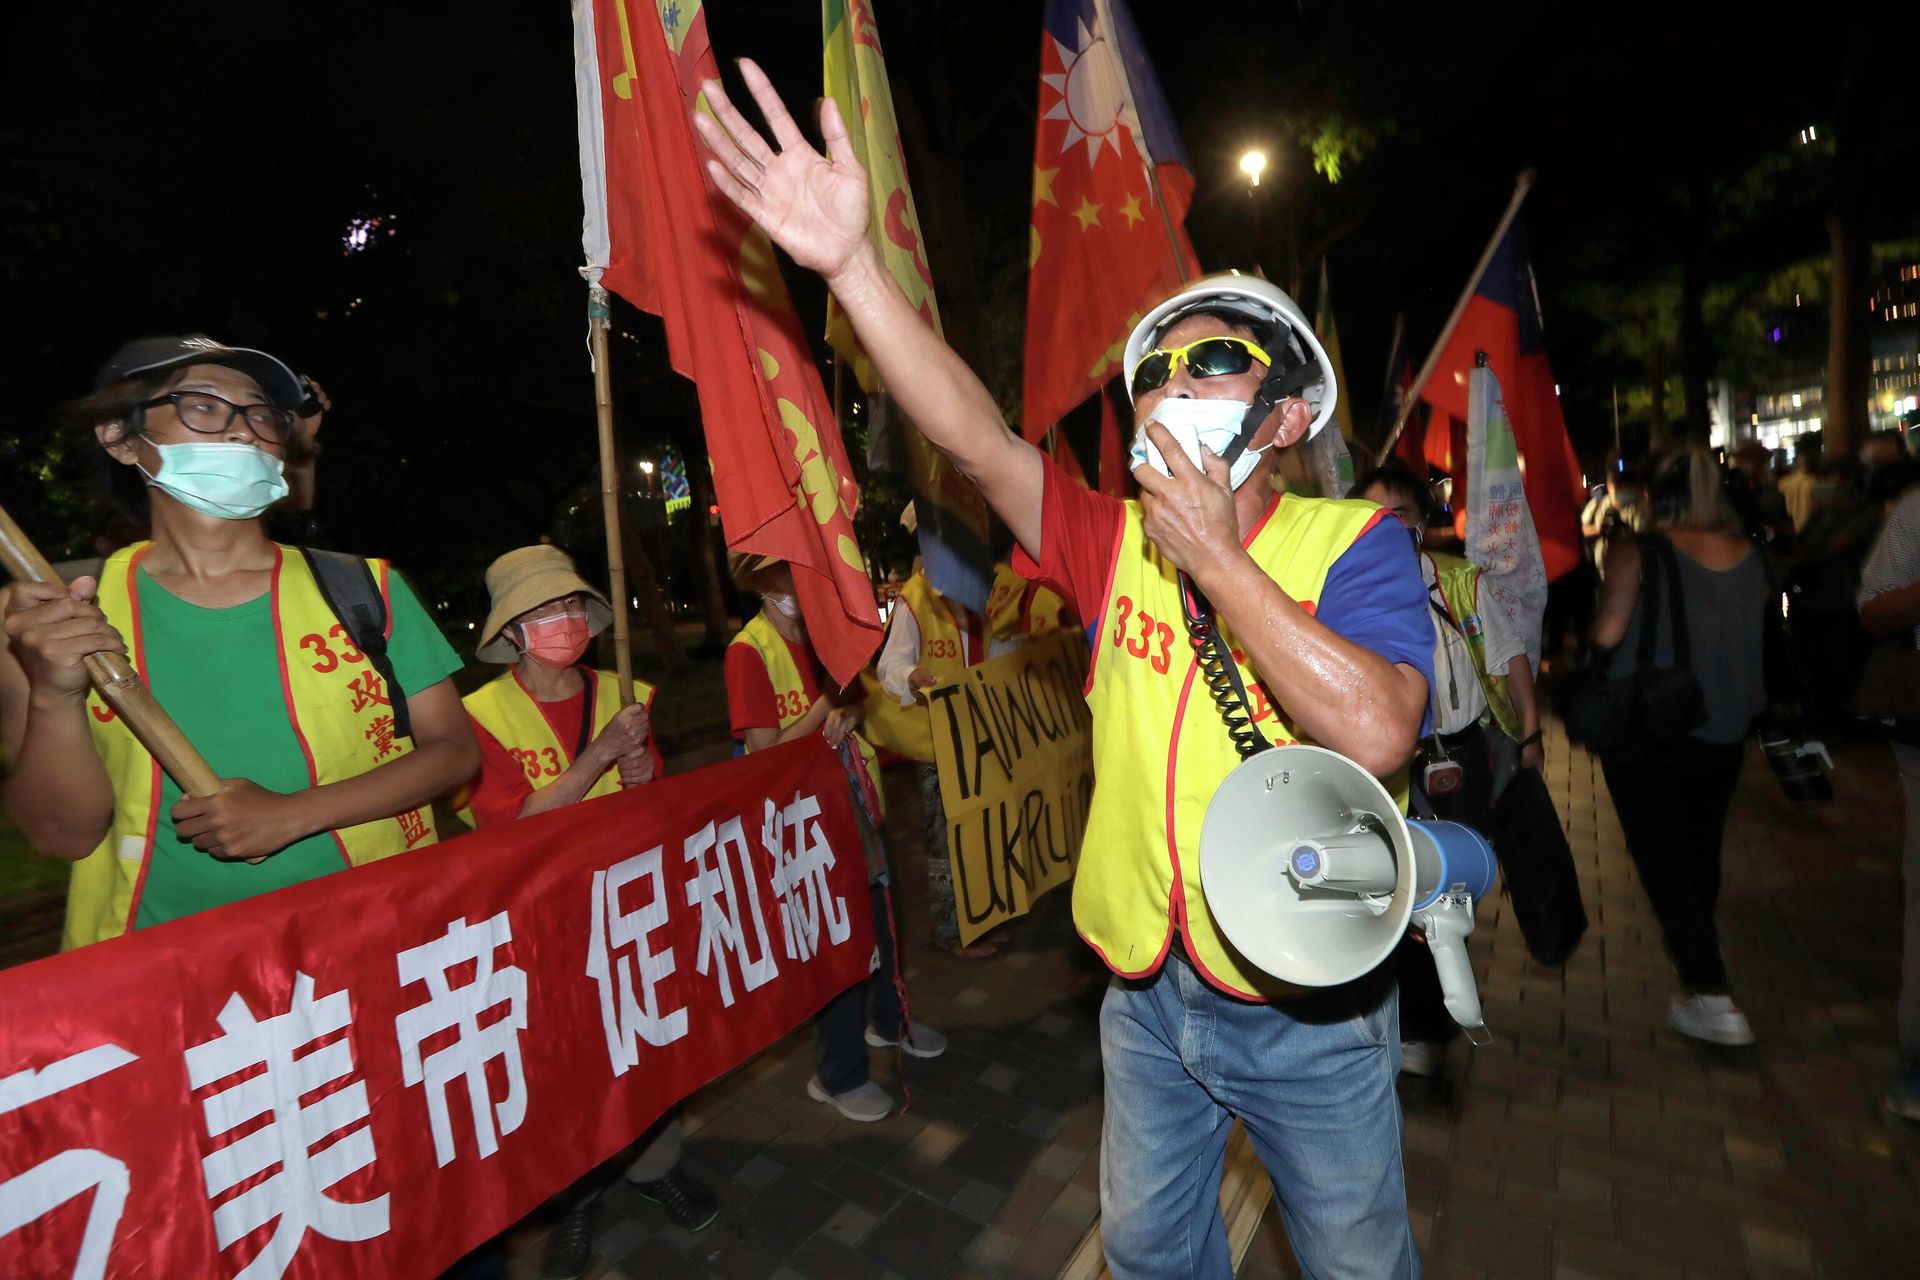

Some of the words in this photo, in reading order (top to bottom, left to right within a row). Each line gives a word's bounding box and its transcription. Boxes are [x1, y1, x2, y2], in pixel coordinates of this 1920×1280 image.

[927, 640, 957, 659] 333
[1114, 596, 1175, 675] 333
[586, 790, 851, 1077] 促和統
